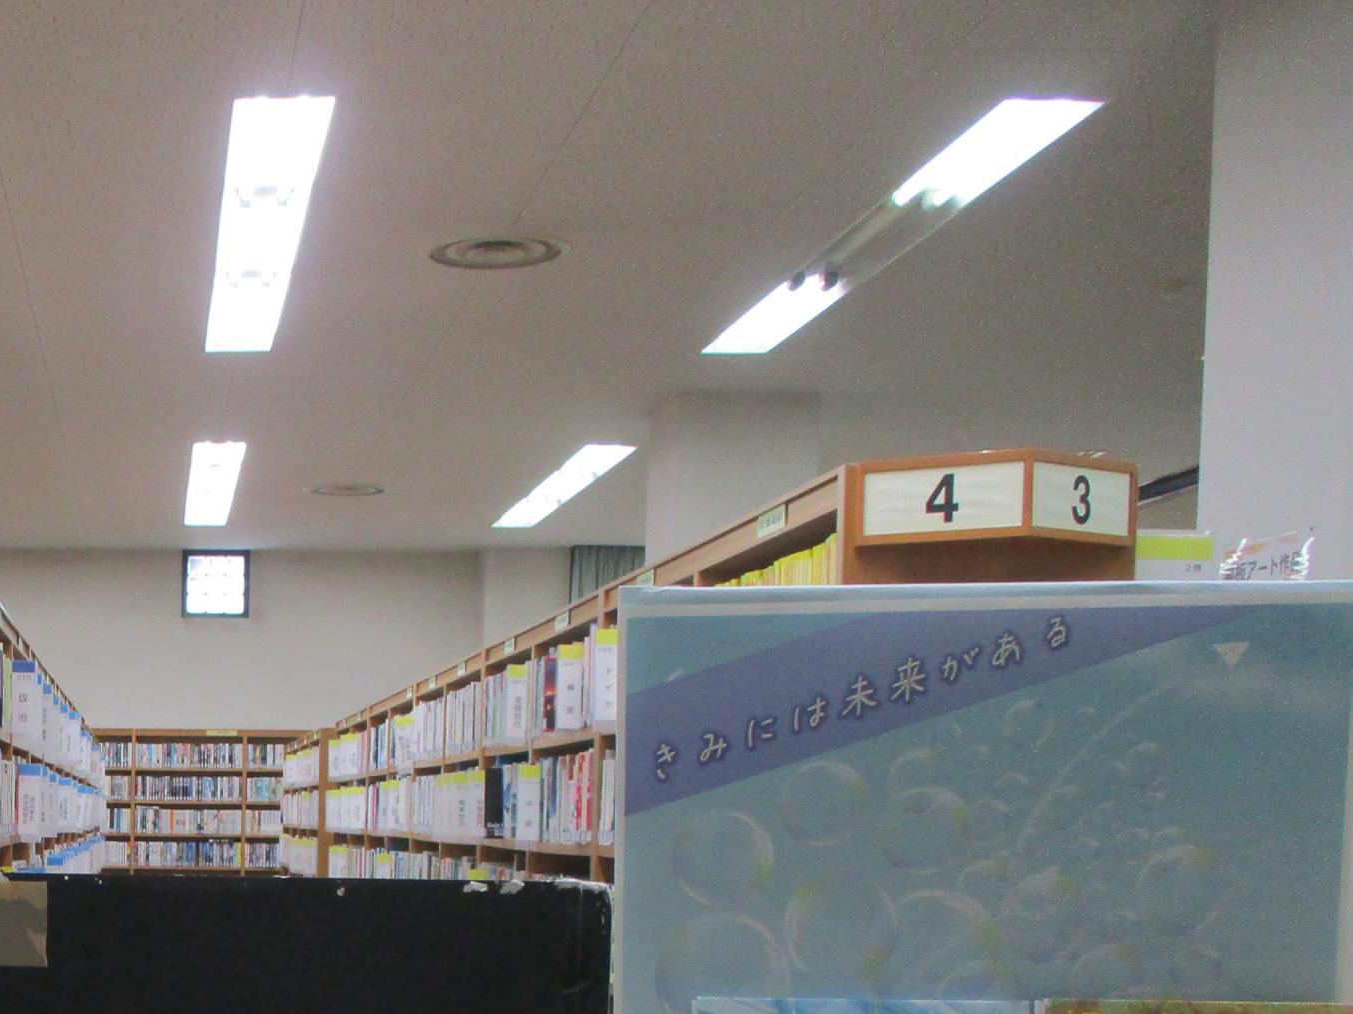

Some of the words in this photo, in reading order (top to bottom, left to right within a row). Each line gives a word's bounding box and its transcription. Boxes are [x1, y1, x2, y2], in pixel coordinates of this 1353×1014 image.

[926, 474, 959, 523] 4
[1072, 475, 1091, 525] 3
[654, 616, 1071, 781] きみには未来がある
